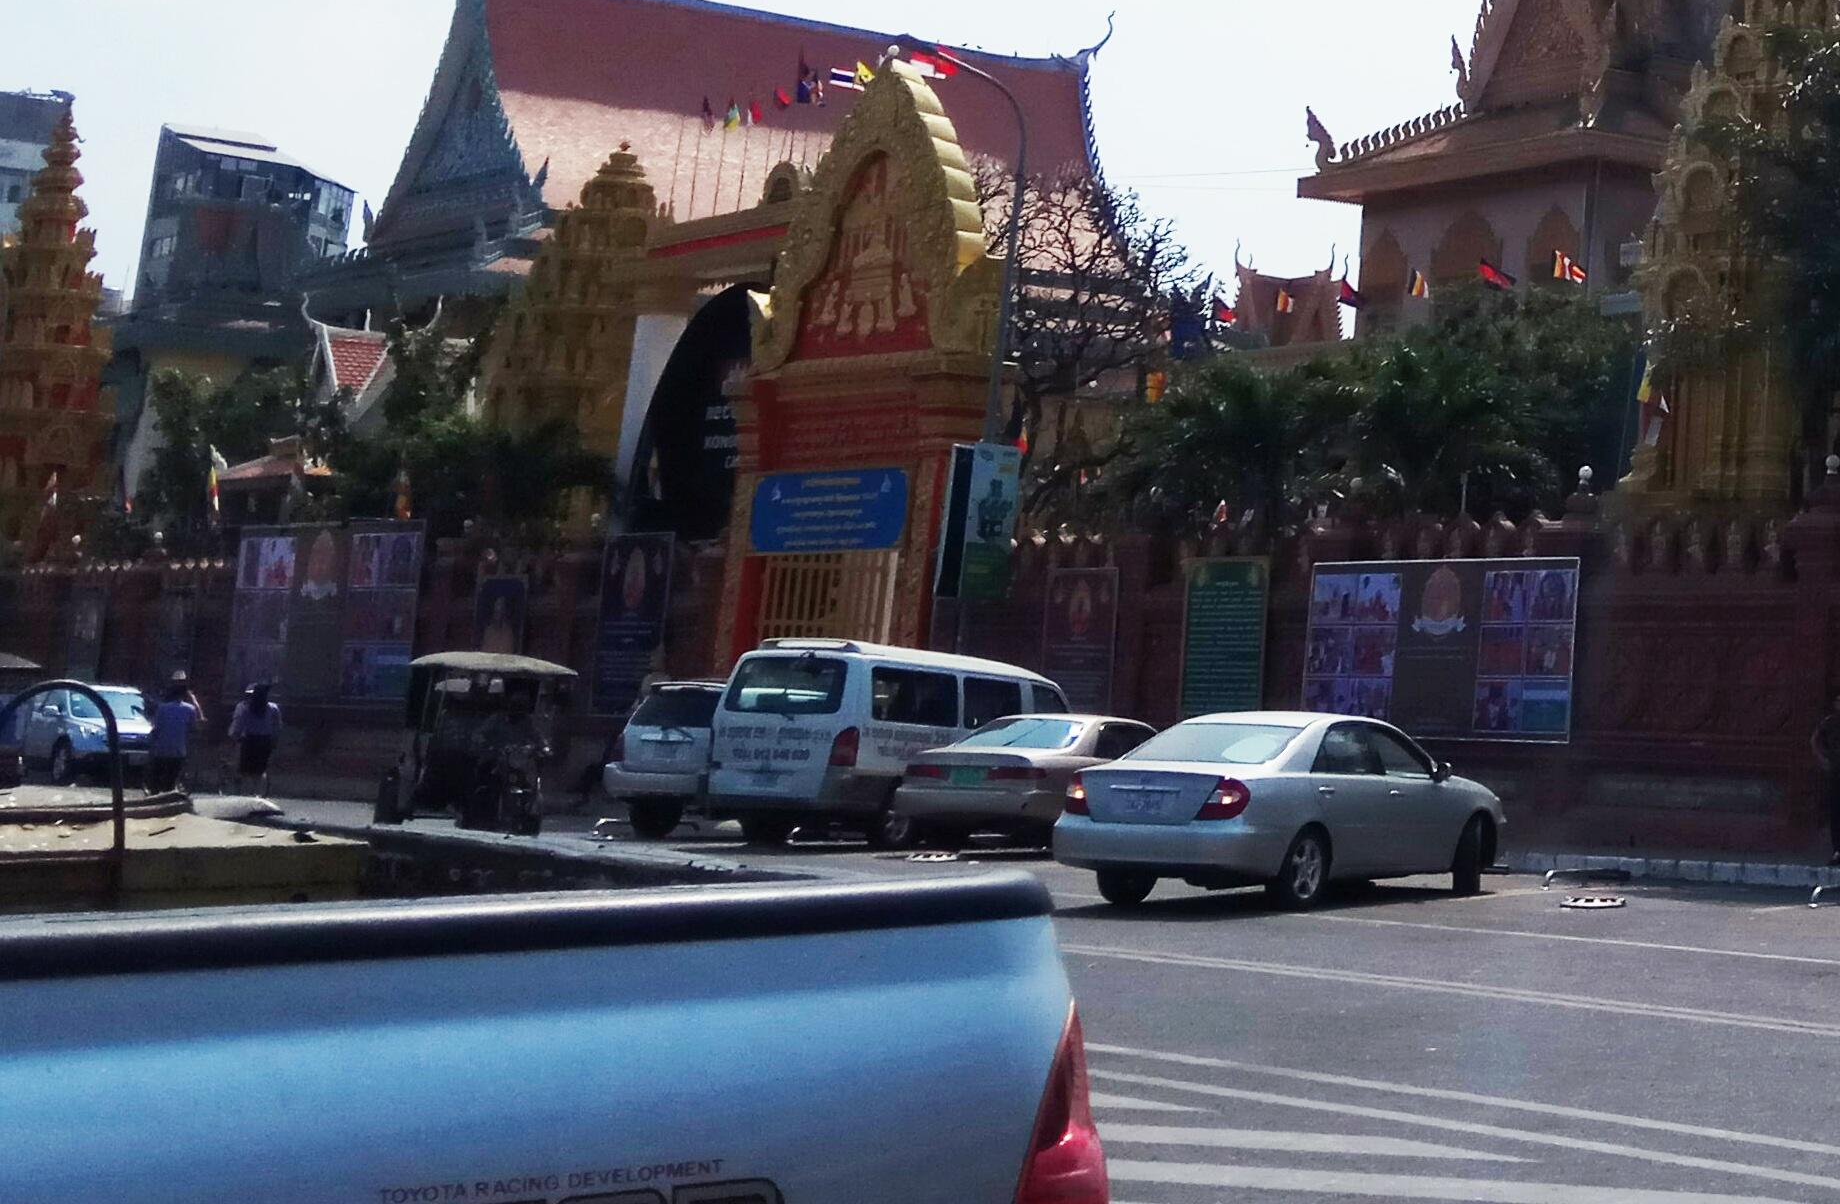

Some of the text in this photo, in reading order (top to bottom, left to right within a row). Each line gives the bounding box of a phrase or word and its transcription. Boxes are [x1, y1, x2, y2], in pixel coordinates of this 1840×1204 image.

[380, 1181, 467, 1204] TOYOTA
[475, 1175, 560, 1196] RACING
[569, 1159, 725, 1189] DEVELOPMENT
